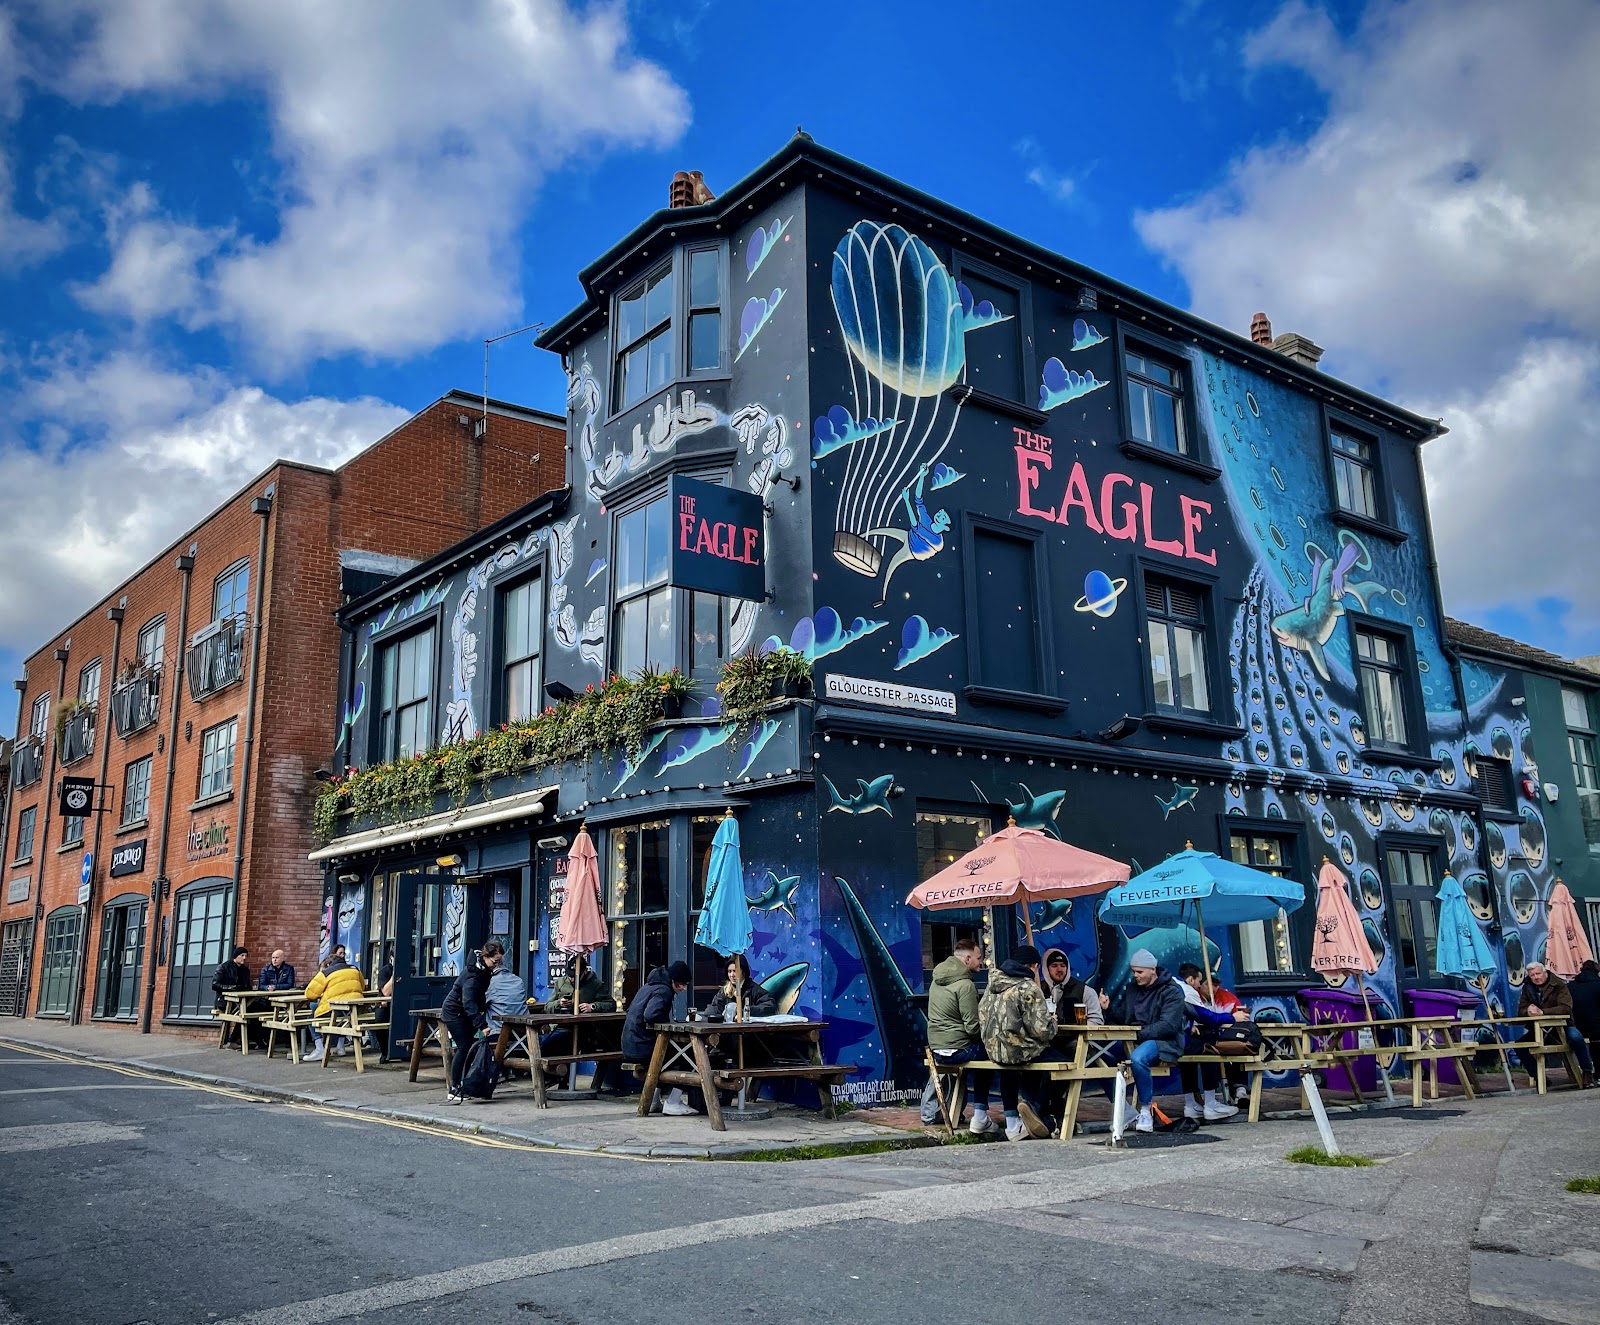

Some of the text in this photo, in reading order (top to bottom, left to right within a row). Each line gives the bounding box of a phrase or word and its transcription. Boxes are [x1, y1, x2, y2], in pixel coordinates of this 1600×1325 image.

[1013, 427, 1052, 454] THE
[679, 495, 696, 515] THE
[1014, 446, 1217, 566] EAGLE
[679, 513, 759, 566] EAGLE
[829, 680, 954, 709] GLOUCESTER PASSAGE
[925, 881, 1003, 901] FEVER-TREE
[1120, 885, 1198, 901] FEVER-TREE
